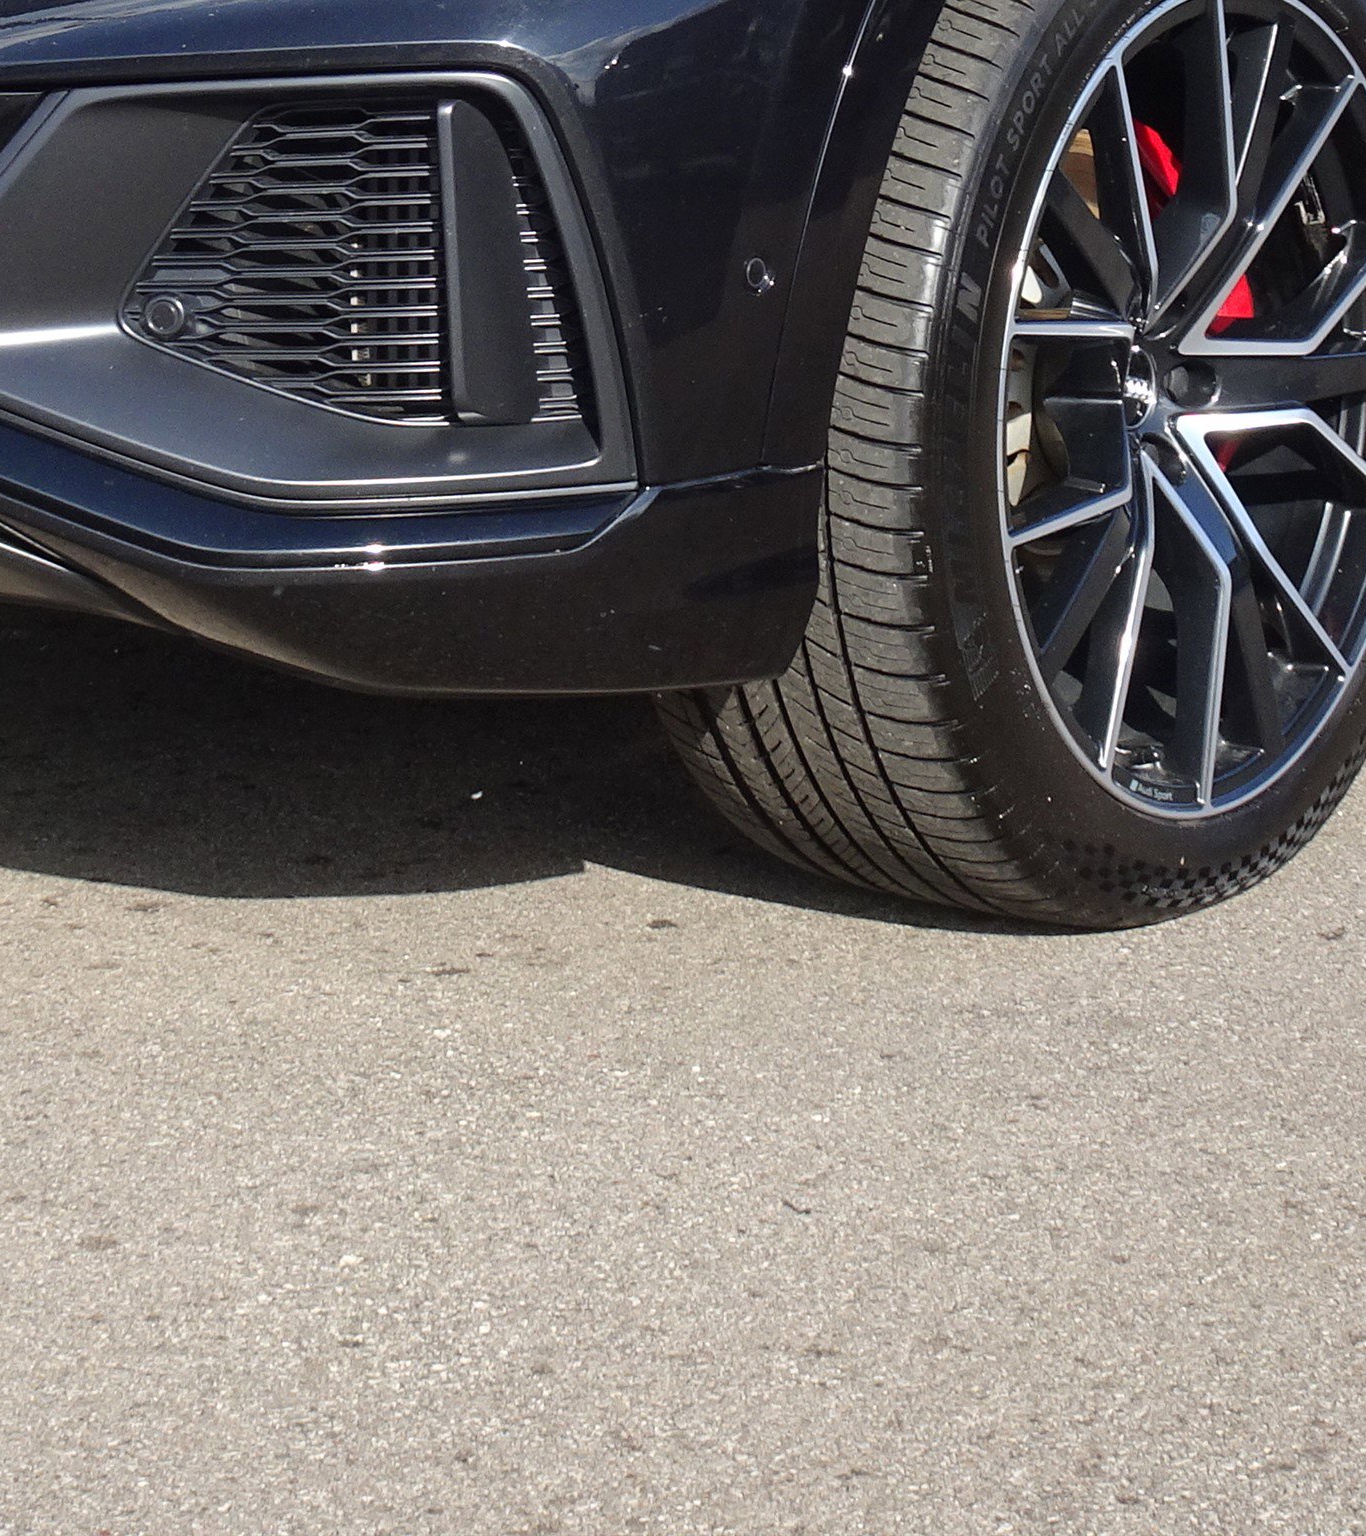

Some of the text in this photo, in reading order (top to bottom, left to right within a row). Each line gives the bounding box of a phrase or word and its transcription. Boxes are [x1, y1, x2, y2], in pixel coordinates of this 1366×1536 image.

[975, 155, 1012, 249] PILOT
[1006, 53, 1055, 152] SPORT
[1053, 7, 1089, 58] ALL
